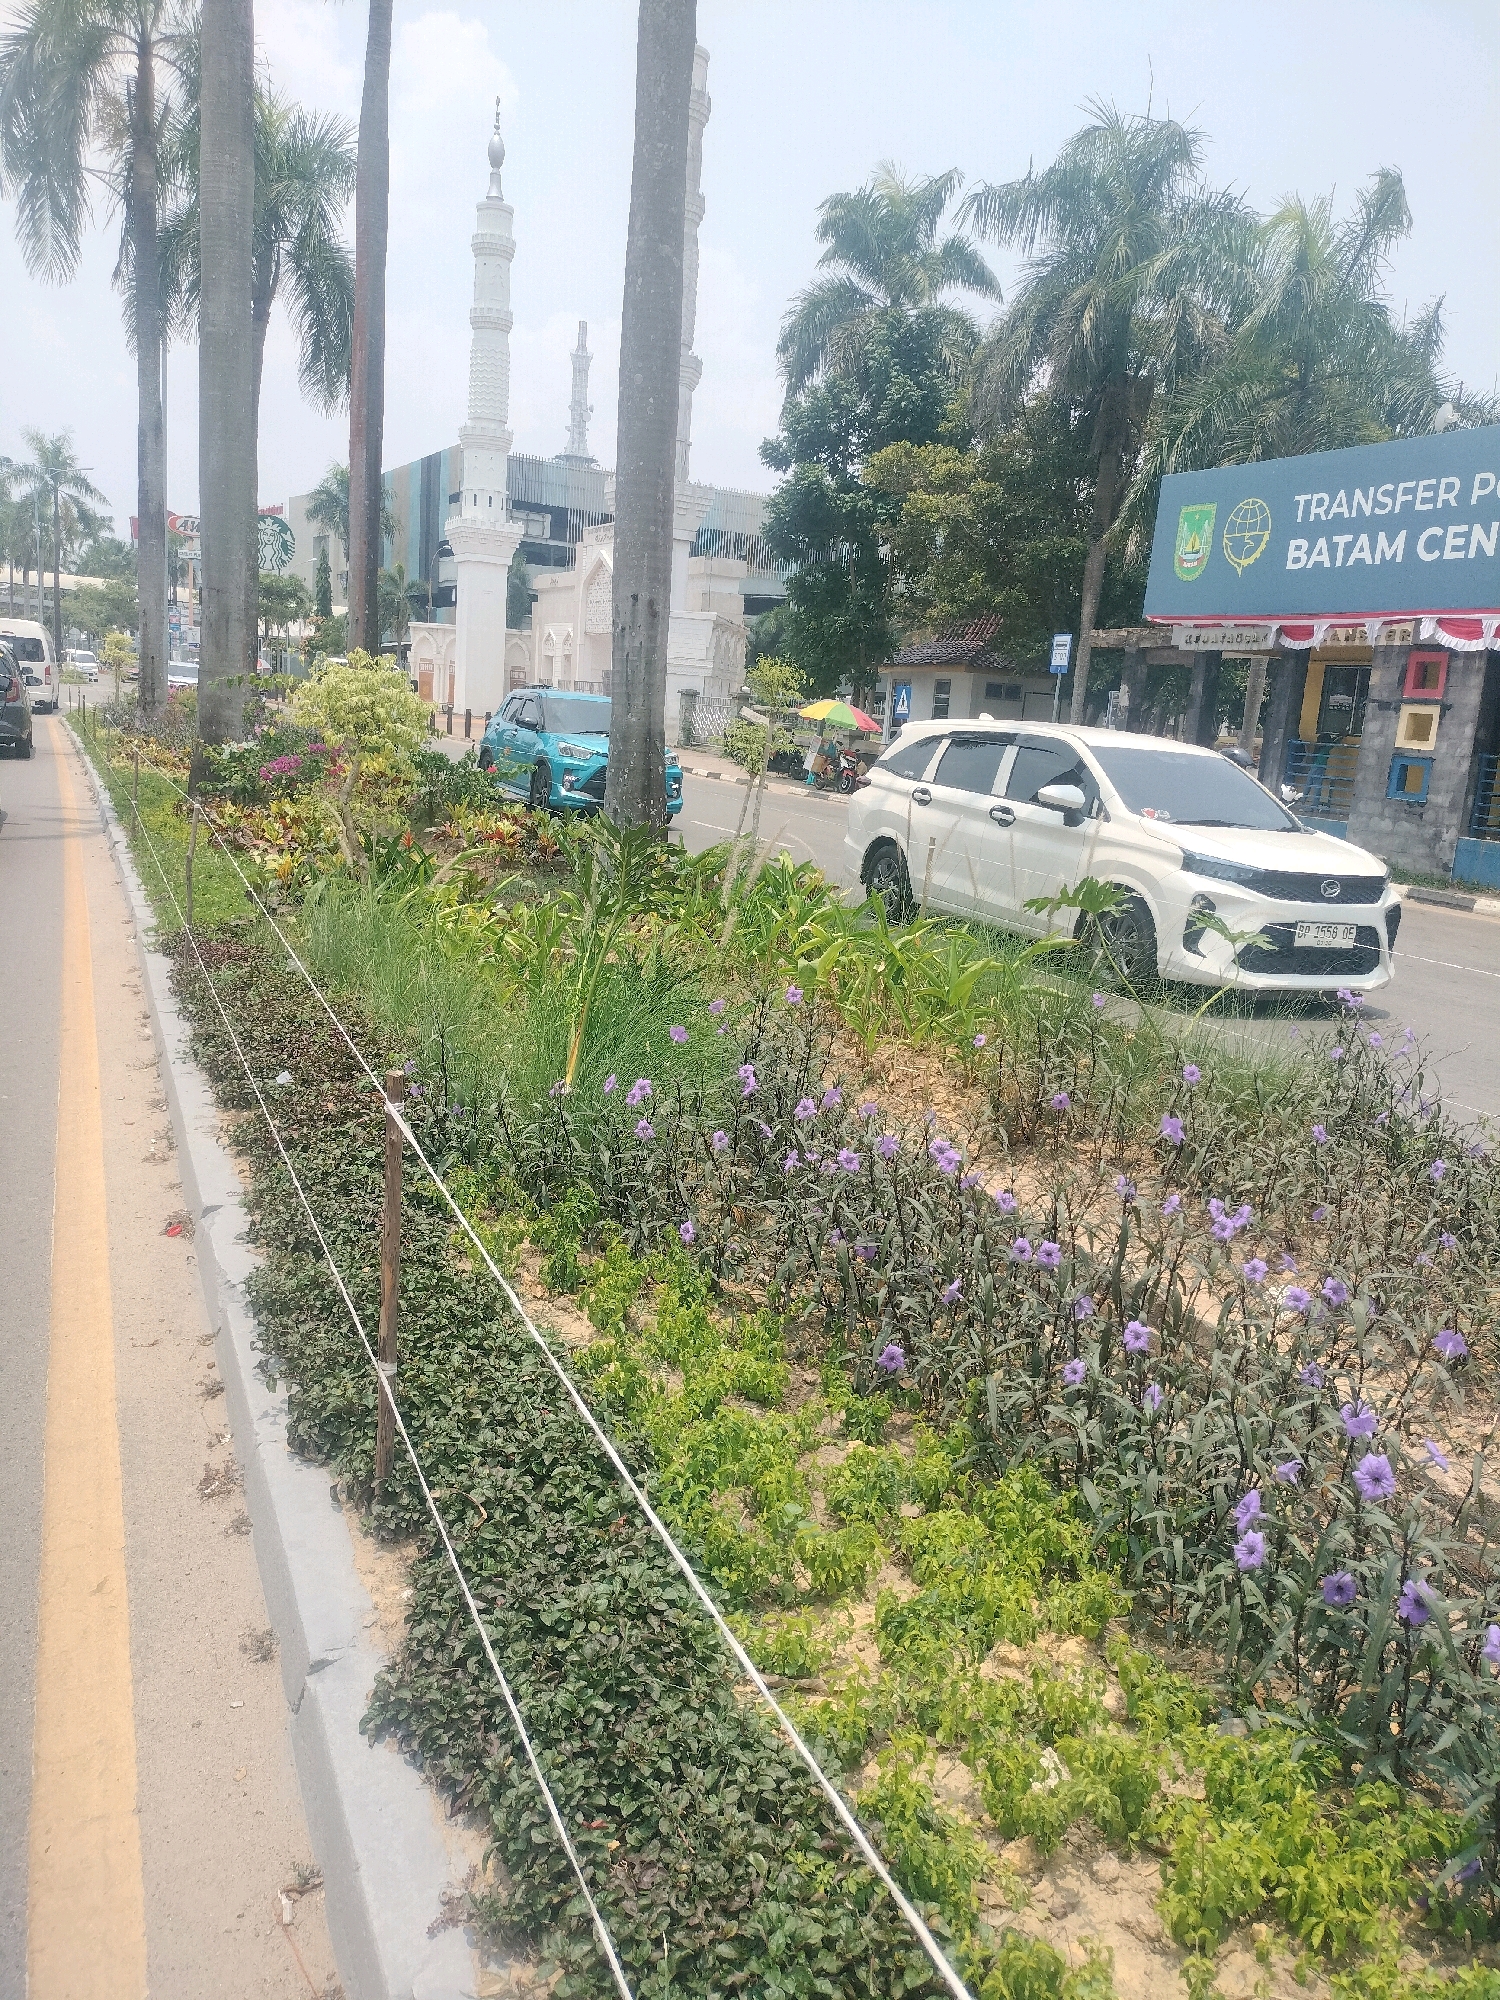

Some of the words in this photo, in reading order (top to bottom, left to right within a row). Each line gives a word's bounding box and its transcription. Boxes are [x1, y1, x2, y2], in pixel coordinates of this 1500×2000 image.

[1293, 476, 1460, 523] TRANSFER
[1470, 472, 1500, 506] P
[1285, 529, 1407, 569] BATAM
[1416, 521, 1500, 562] CEN
[1297, 925, 1311, 939] BP
